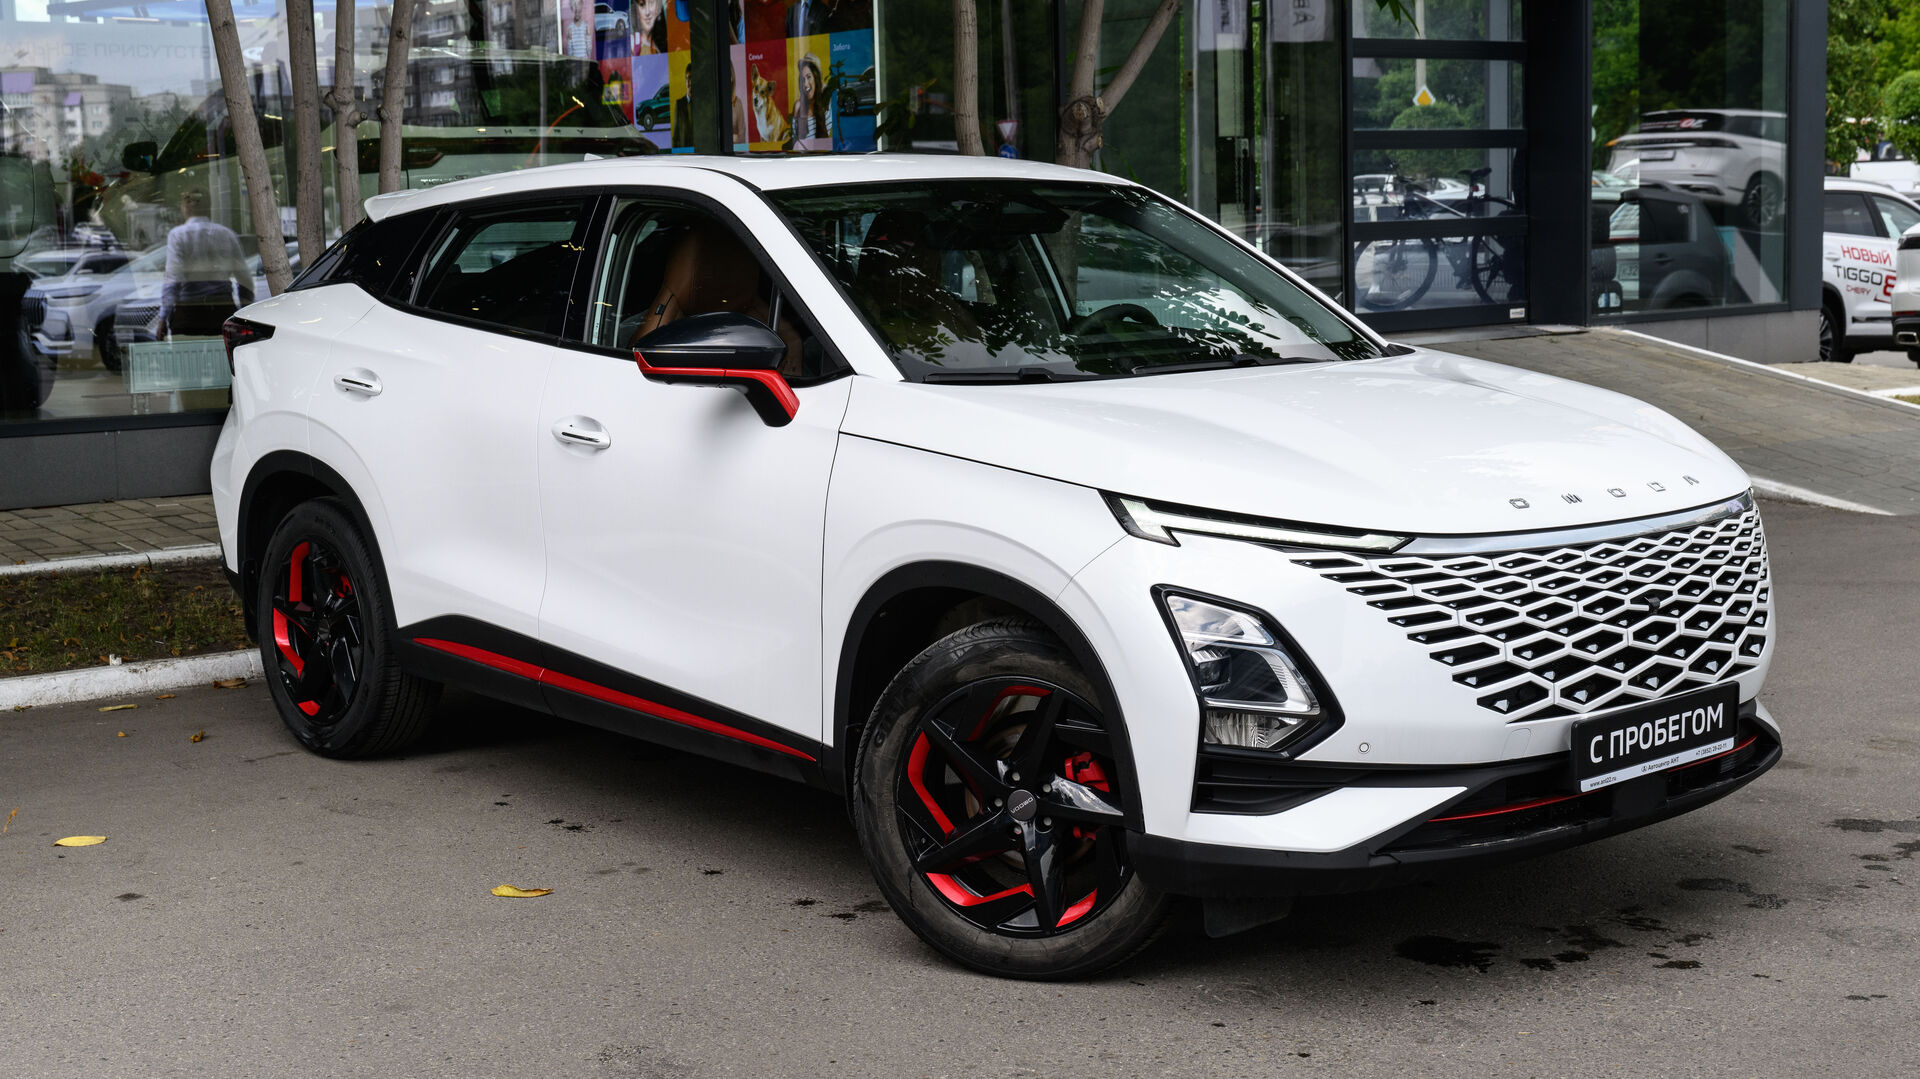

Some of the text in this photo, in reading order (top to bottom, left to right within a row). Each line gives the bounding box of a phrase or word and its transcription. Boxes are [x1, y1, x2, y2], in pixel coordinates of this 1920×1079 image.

[1841, 245, 1892, 266] НОВЫЙ
[1590, 702, 1724, 764] С ПРОБЕГОМ
[1647, 759, 1670, 772] Автоцентр
